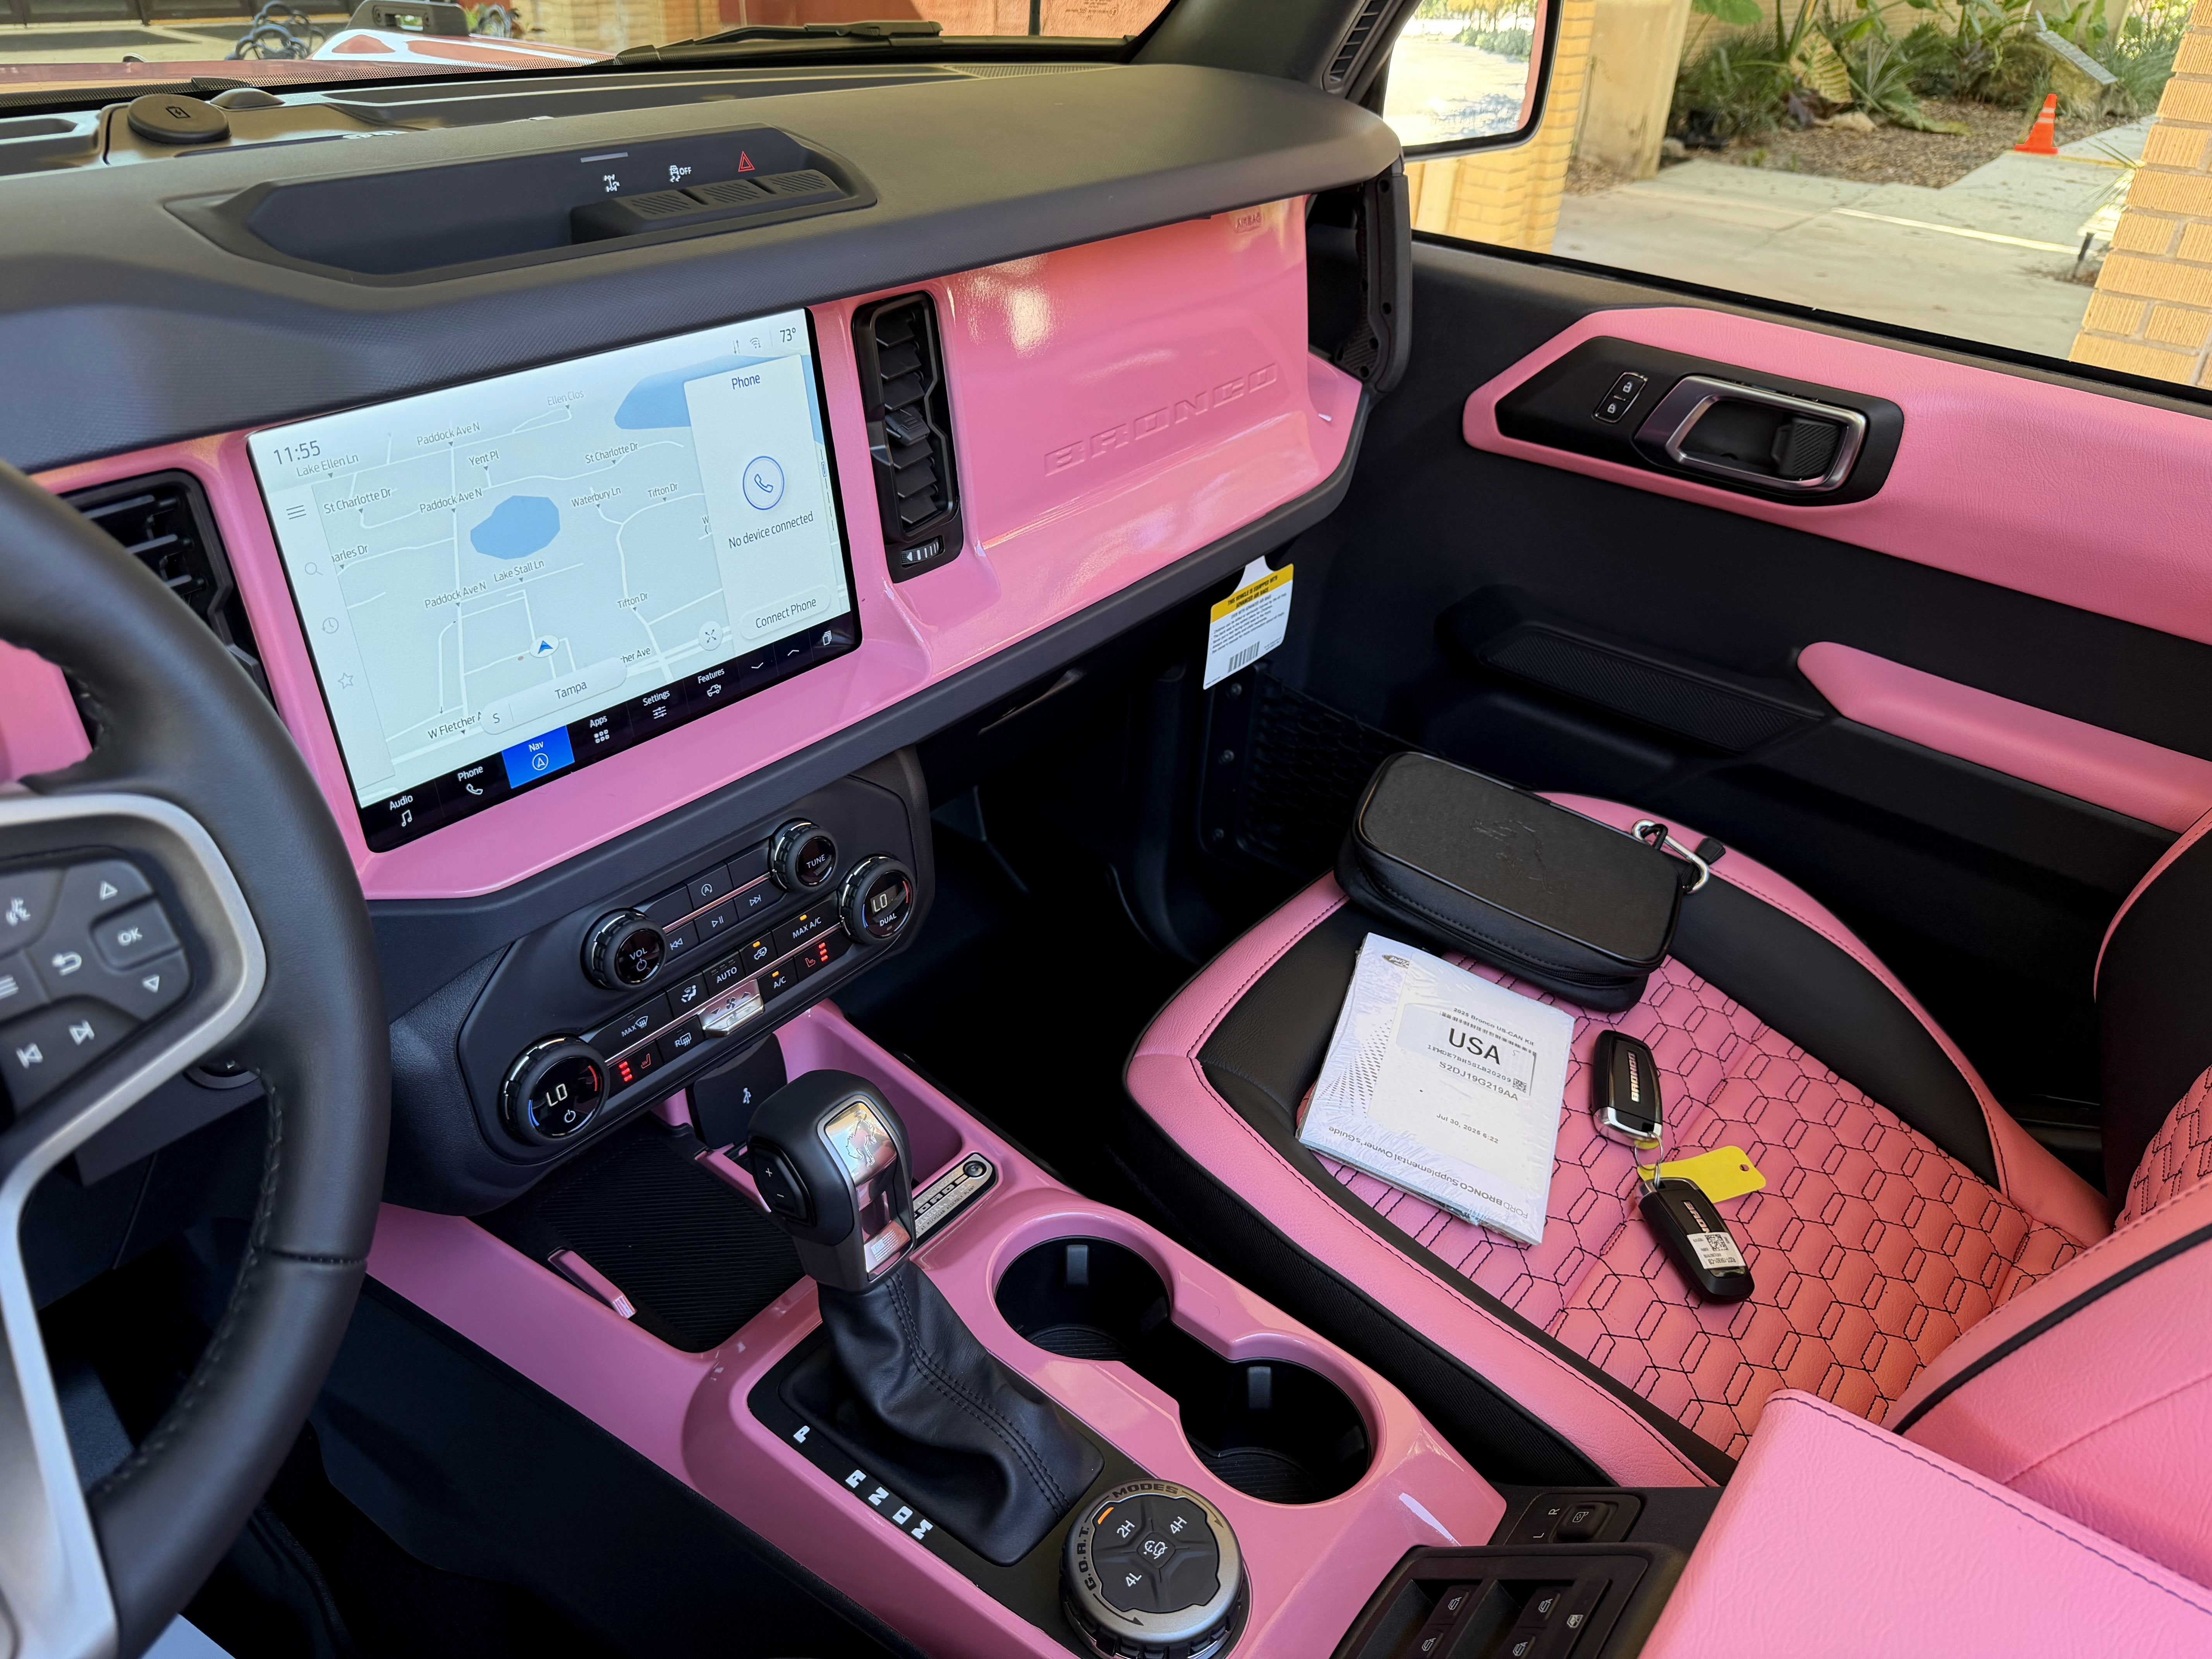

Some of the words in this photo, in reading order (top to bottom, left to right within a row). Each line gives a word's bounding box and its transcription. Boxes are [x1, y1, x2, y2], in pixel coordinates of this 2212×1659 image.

[679, 166, 692, 175] OFF
[732, 373, 761, 390] Phone
[547, 395, 567, 405] Ellen
[568, 391, 584, 401] Clos
[1044, 362, 1279, 477] BRONCO
[417, 429, 455, 446] Paddock
[457, 426, 472, 436] Ave
[473, 422, 480, 431] N
[274, 440, 320, 465] 11:55
[469, 454, 489, 465] Yent
[490, 450, 499, 460] Pl
[586, 454, 593, 464] St
[595, 446, 629, 461] Charlotte
[630, 443, 638, 451] Dr
[297, 465, 320, 477] Lake
[321, 458, 345, 471] Ellen
[347, 455, 359, 464] Ln
[572, 491, 610, 507] Waterbury
[611, 487, 621, 495] Ln
[647, 486, 669, 498] Tifton
[670, 483, 678, 491] Dr
[324, 503, 335, 514] St
[337, 492, 380, 510] Charlotte
[381, 488, 391, 498] Dr
[420, 495, 457, 513] Paddock
[459, 491, 474, 502] Ave
[475, 488, 483, 497] N
[729, 537, 741, 548] No
[743, 528, 770, 544] device
[771, 511, 813, 534] connected
[357, 545, 368, 555] Dr
[494, 570, 513, 582] Lake
[515, 562, 533, 575] Stall
[534, 560, 544, 569] Ln
[425, 590, 462, 608] Paddock
[463, 586, 478, 596] Ave
[480, 582, 486, 590] N
[617, 594, 639, 609] Tifton
[639, 592, 649, 602] Dr
[755, 608, 789, 629] Connect
[790, 598, 817, 615] Phone
[620, 653, 636, 663] her
[637, 648, 651, 659] Ave
[697, 668, 725, 684] Features
[555, 681, 587, 699] Tampa
[643, 690, 670, 706] Settings
[428, 728, 438, 739] W
[440, 715, 476, 735] Fletcher
[493, 713, 500, 723] S
[590, 715, 608, 728] Apps
[528, 740, 544, 752] Nav
[458, 766, 483, 781] Phone
[389, 795, 414, 811] Audio
[806, 854, 826, 869] TUNE
[872, 893, 889, 912] LO
[793, 925, 808, 939] MAX
[810, 917, 822, 928] A/C
[879, 913, 897, 927] DUAL
[117, 927, 143, 946] OK
[629, 947, 647, 960] VOL
[716, 967, 737, 983] AUTO
[773, 976, 787, 989] A/C
[621, 1025, 637, 1037] MAX
[1453, 1008, 1469, 1017] 2025
[1471, 1015, 1495, 1028] Bronco
[1496, 1025, 1523, 1041] US-CAN
[1525, 1037, 1534, 1046] Kit
[1449, 1028, 1500, 1065] USA
[1439, 1061, 1518, 1101] S2DJ19G219AA
[1628, 1052, 1640, 1102] BRONCO
[546, 1084, 568, 1107] LO
[1329, 1126, 1355, 1142] Guide
[1450, 1119, 1461, 1128] 30,
[1463, 1125, 1480, 1135] 2025
[1483, 1133, 1498, 1144] 6:22
[1356, 1137, 1393, 1158] Owner's
[1394, 1154, 1459, 1187] Supplemental
[1460, 1183, 1502, 1206] BRONCO
[927, 1210, 945, 1224] MICHIGAN
[947, 1195, 963, 1209] ASSEMBLY
[964, 1186, 975, 1195] PLANT
[1503, 1202, 1528, 1219] FORD
[916, 1203, 947, 1229] EARBORN,
[793, 1425, 810, 1443] P
[845, 1469, 867, 1488] R
[868, 1487, 889, 1506] N
[892, 1506, 913, 1525] D
[911, 1519, 933, 1540] M
[1117, 1520, 1135, 1538] 2H
[1170, 1516, 1187, 1534] 4H
[1077, 1526, 1097, 1591] G.O.A.T.
[1112, 1483, 1178, 1498] MODES
[1125, 1573, 1142, 1587] 4L
